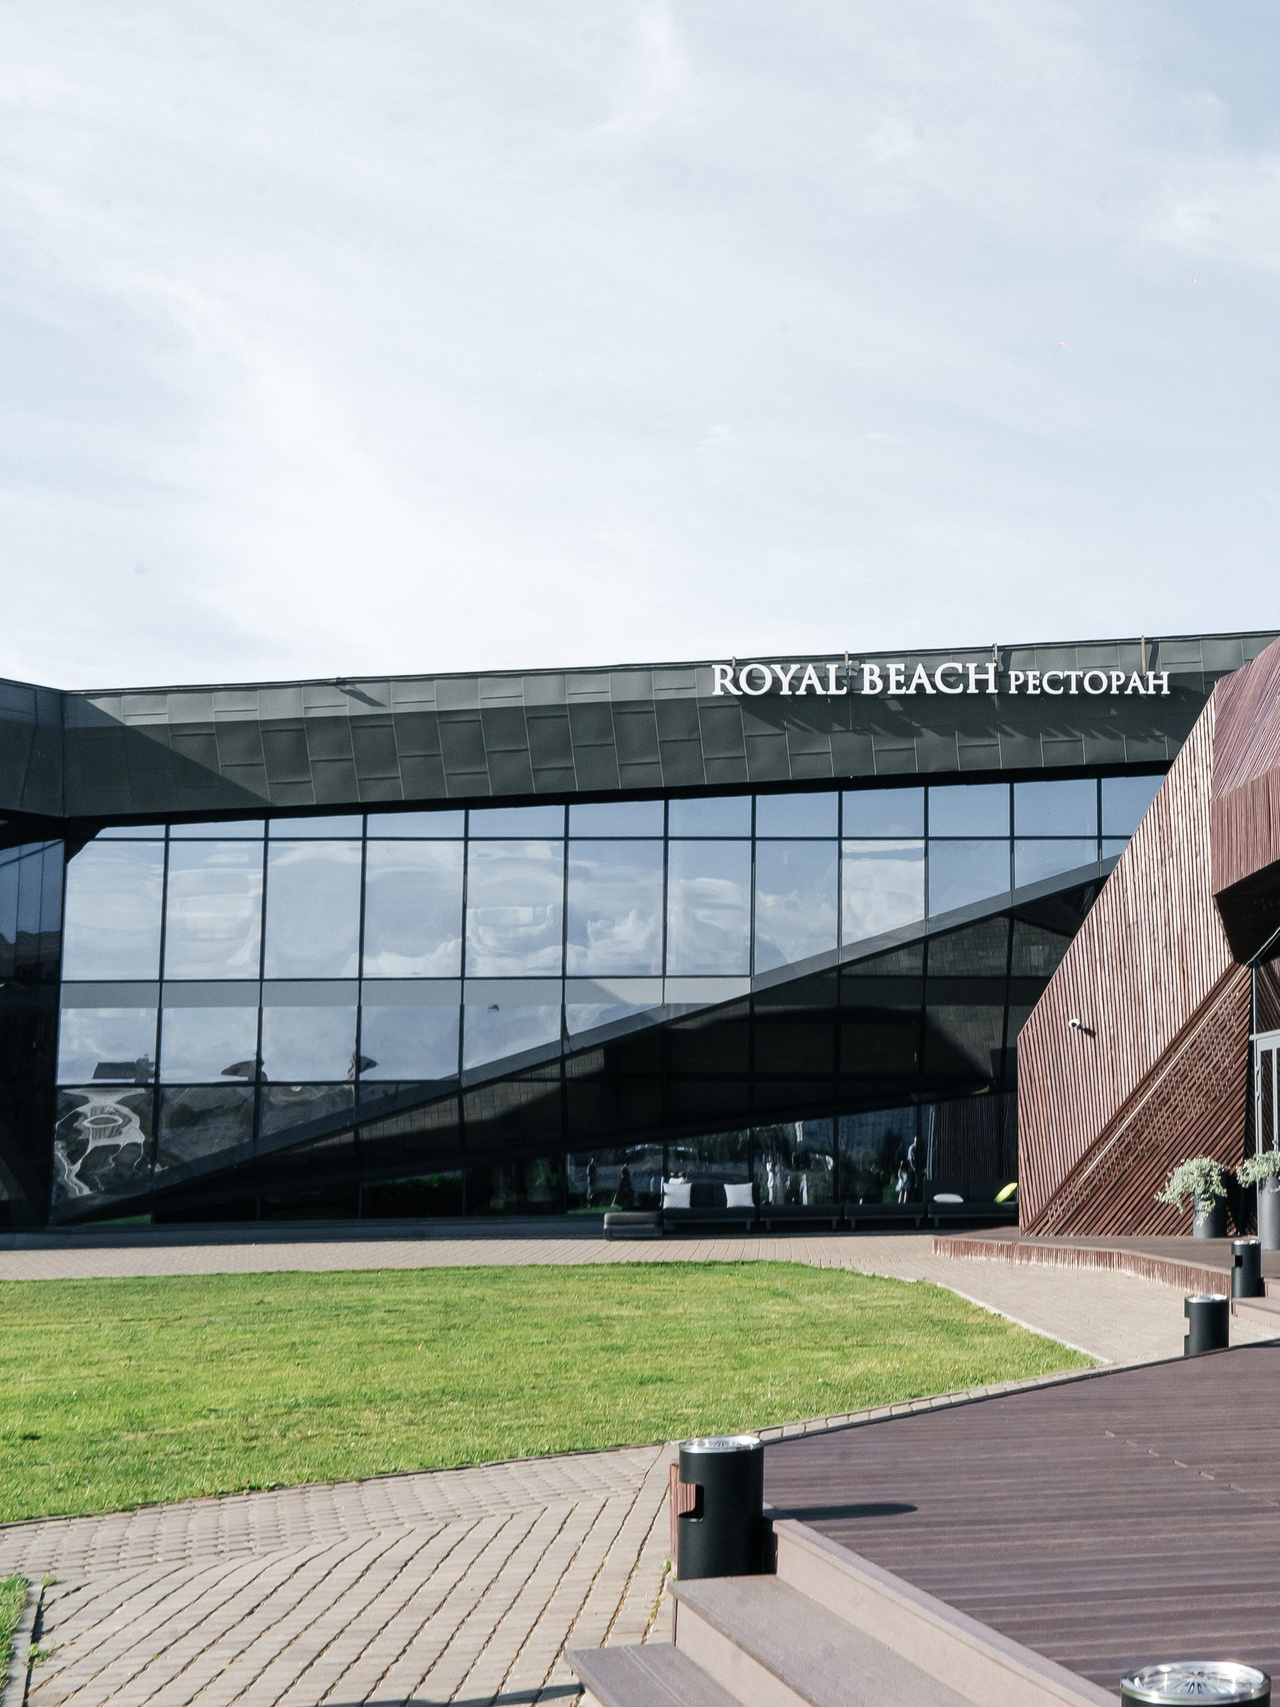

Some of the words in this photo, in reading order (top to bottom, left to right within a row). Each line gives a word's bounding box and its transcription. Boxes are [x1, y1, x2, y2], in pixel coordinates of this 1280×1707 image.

[712, 664, 848, 696] ROYAL
[861, 662, 997, 694] BEACH
[1008, 670, 1170, 695] РЕСТОРАН
